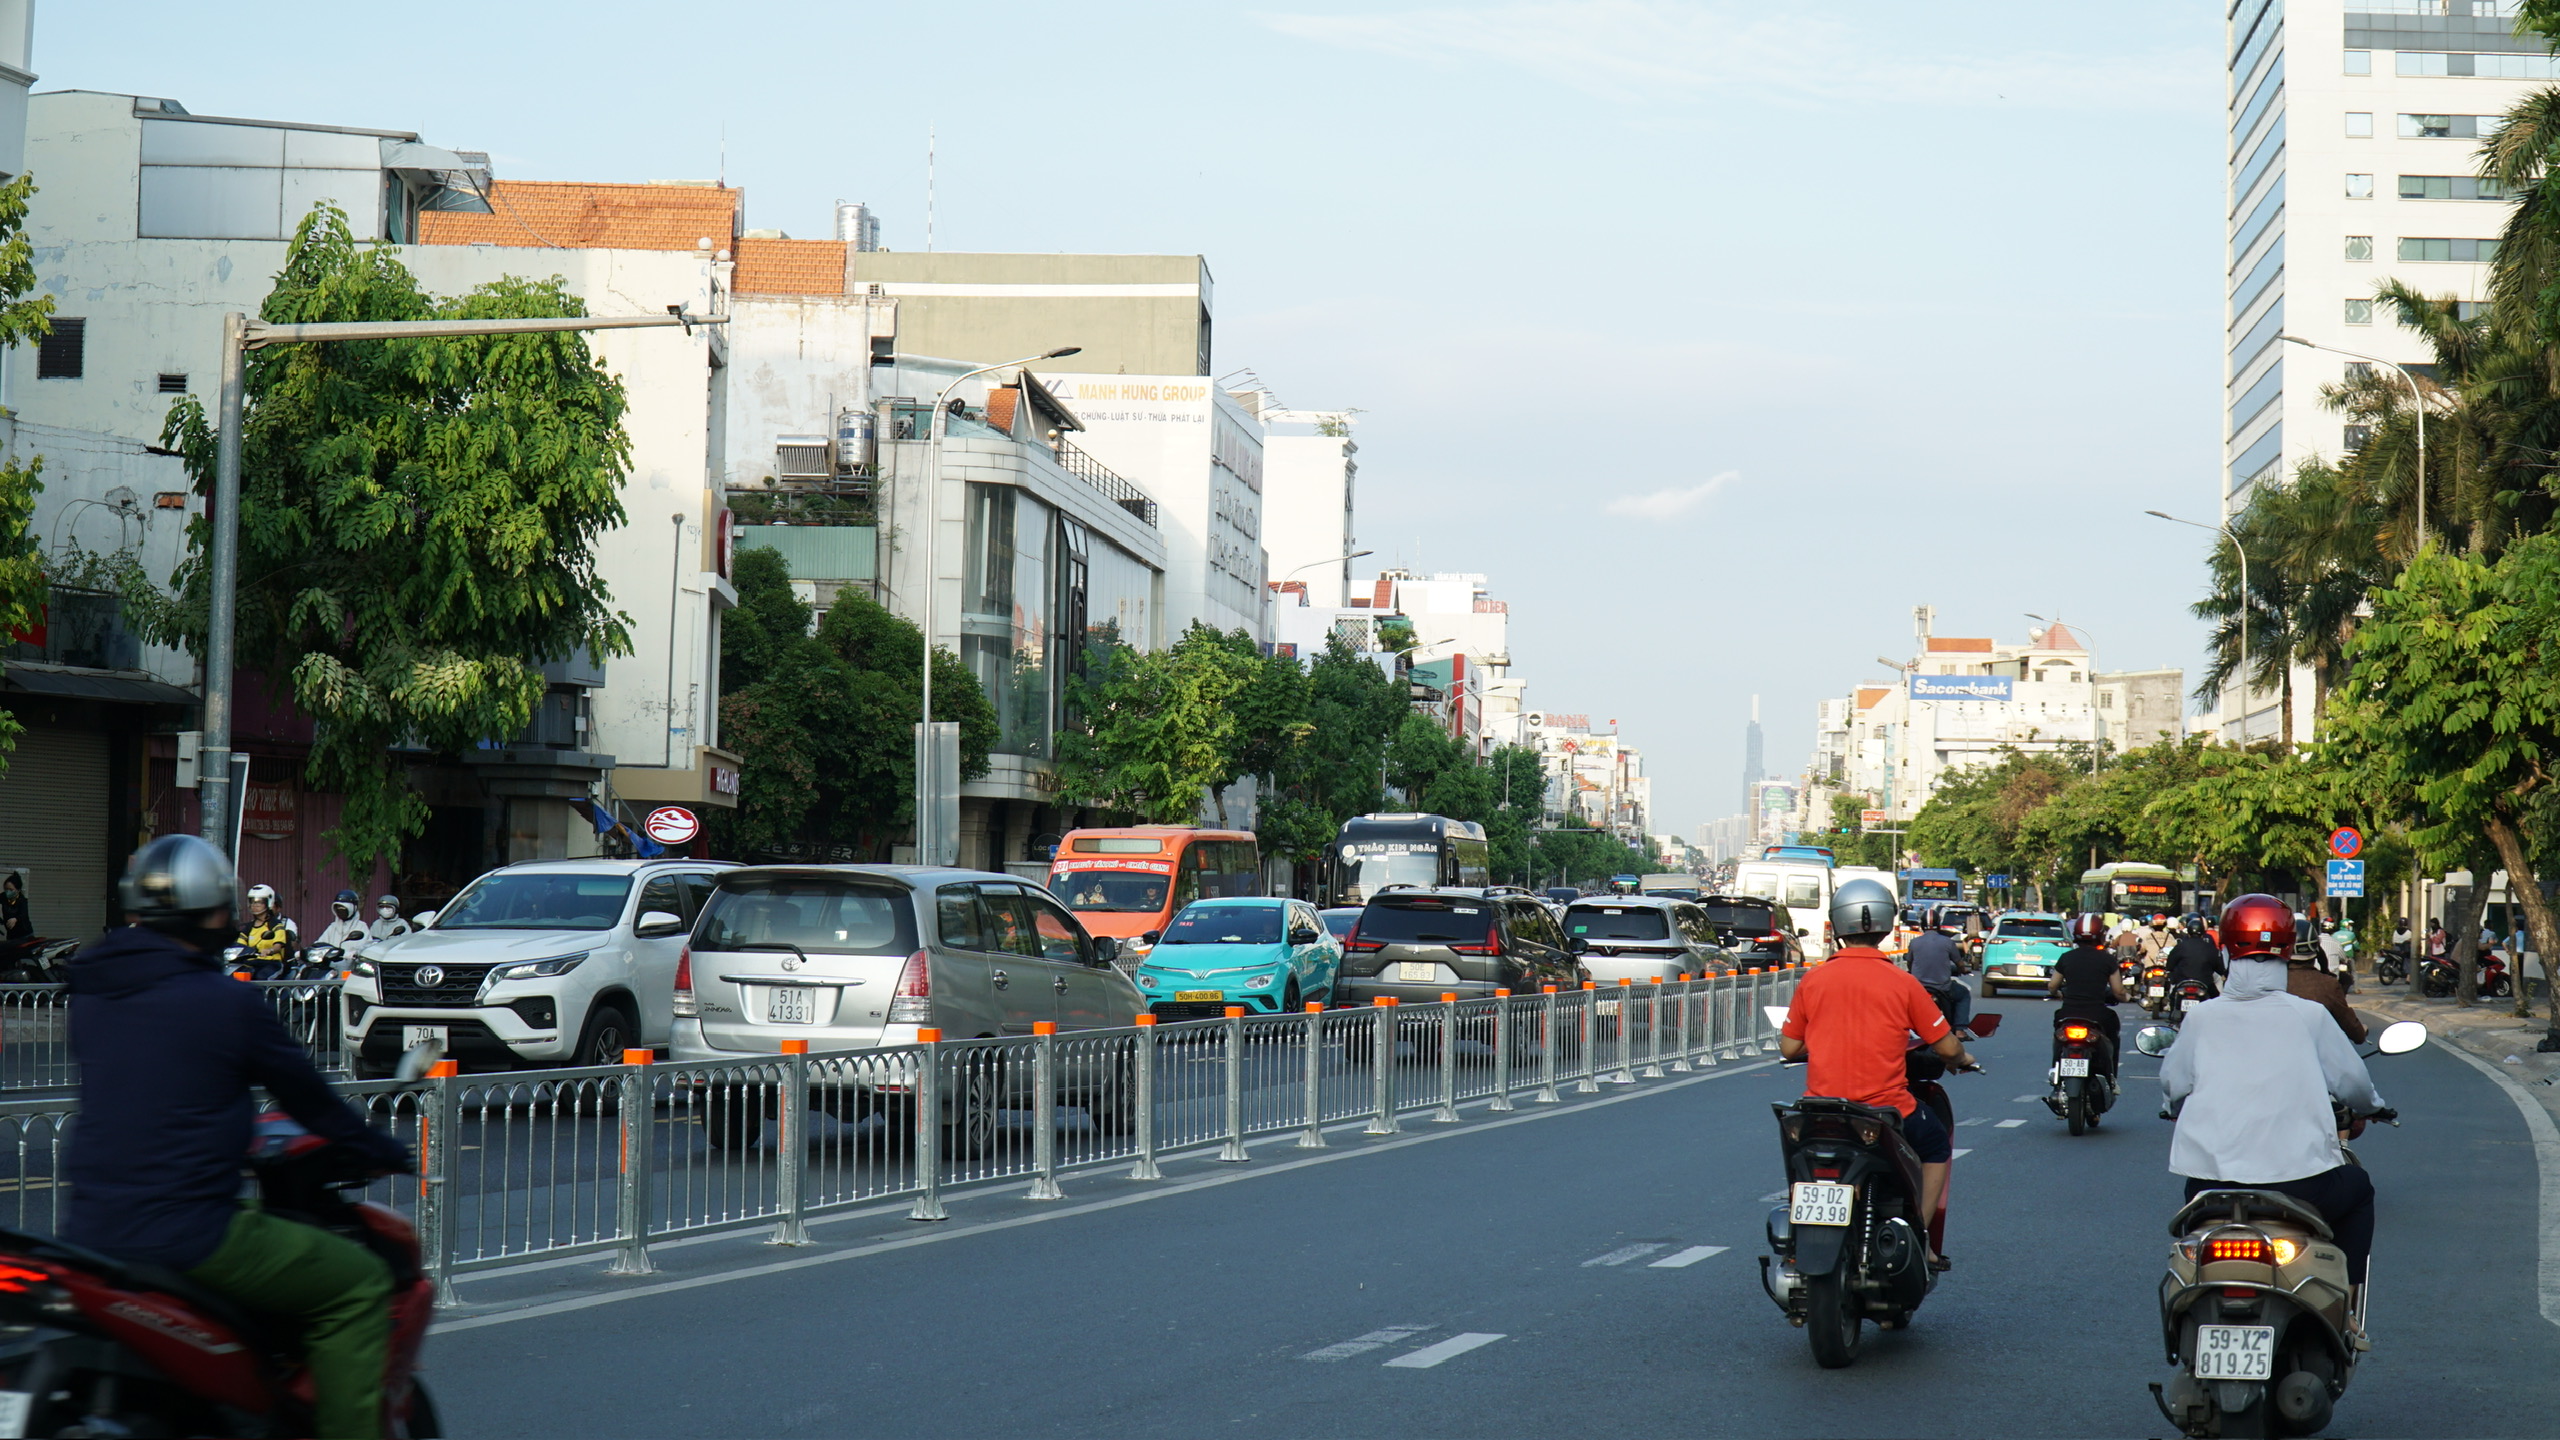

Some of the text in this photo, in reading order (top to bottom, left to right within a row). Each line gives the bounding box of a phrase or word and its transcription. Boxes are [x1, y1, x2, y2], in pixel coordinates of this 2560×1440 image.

[1162, 385, 1206, 402] GROUP
[1473, 600, 1506, 613] HOTEL
[1914, 678, 2008, 696] Sacombank
[1544, 713, 1589, 727] BANK
[716, 767, 740, 795] HIGHLANDS
[1388, 844, 1407, 852] KIM
[779, 989, 803, 1004] 51A
[769, 1005, 810, 1020] 413.31
[416, 1027, 435, 1039] 70A
[1802, 1186, 1844, 1204] 59-D2
[1795, 1205, 1847, 1222] 873.98
[2209, 1329, 2261, 1351] 59-X2
[2201, 1352, 2267, 1375] 819.25
